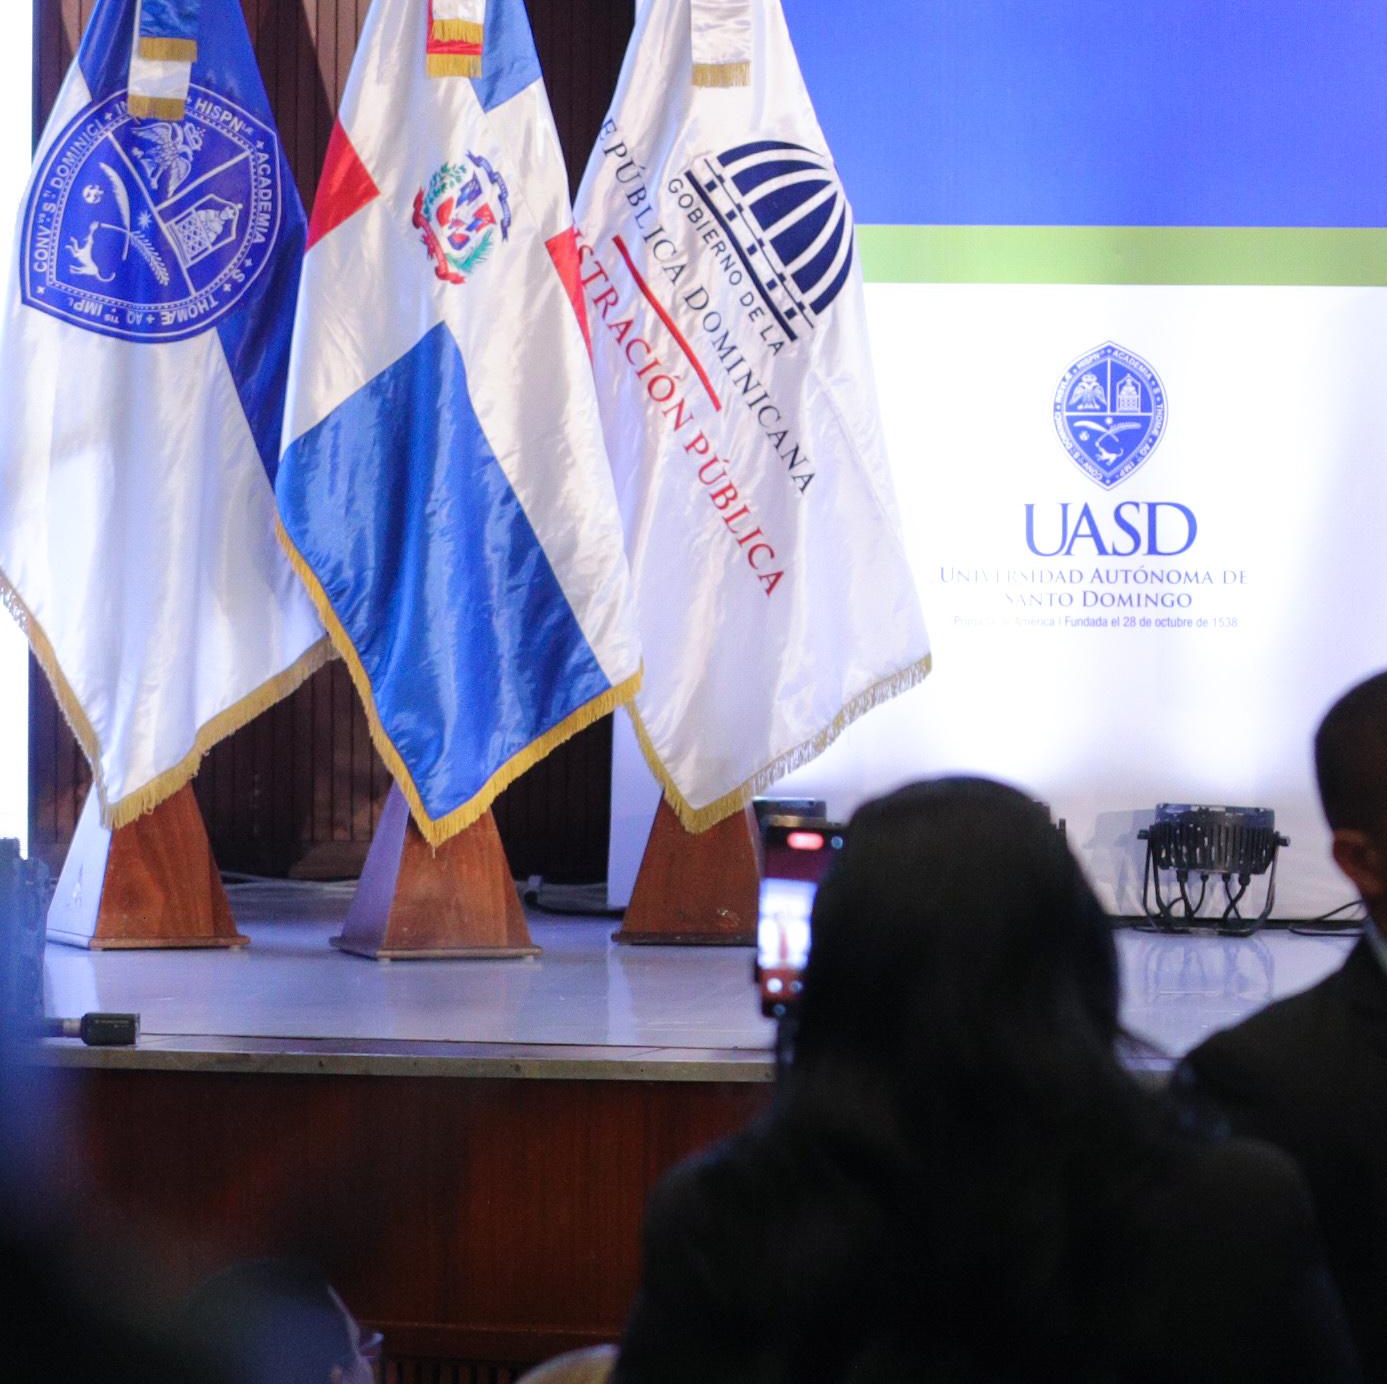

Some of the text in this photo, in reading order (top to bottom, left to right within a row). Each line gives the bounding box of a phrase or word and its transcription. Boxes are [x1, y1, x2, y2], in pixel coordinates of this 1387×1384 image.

[254, 150, 273, 244] ACADEMIA
[668, 177, 785, 357] GOBIERNO DE LA
[599, 118, 817, 496] EPÚBLICA DOMINICANA
[1112, 350, 1151, 380] ACADEMIA
[575, 228, 785, 599] STRACIÓN PÚBLICA
[1023, 500, 1199, 558] UASD
[1082, 590, 1193, 609] DOMINGO
[1089, 564, 1214, 585] AUTÓNOMA
[1222, 567, 1248, 585] DE
[1064, 615, 1109, 628] Fundada
[1111, 615, 1120, 628] el
[1122, 616, 1138, 628] 28
[1138, 615, 1153, 628] de
[1154, 615, 1194, 628] octubre
[1195, 616, 1209, 628] de
[1212, 616, 1239, 628] 1538
